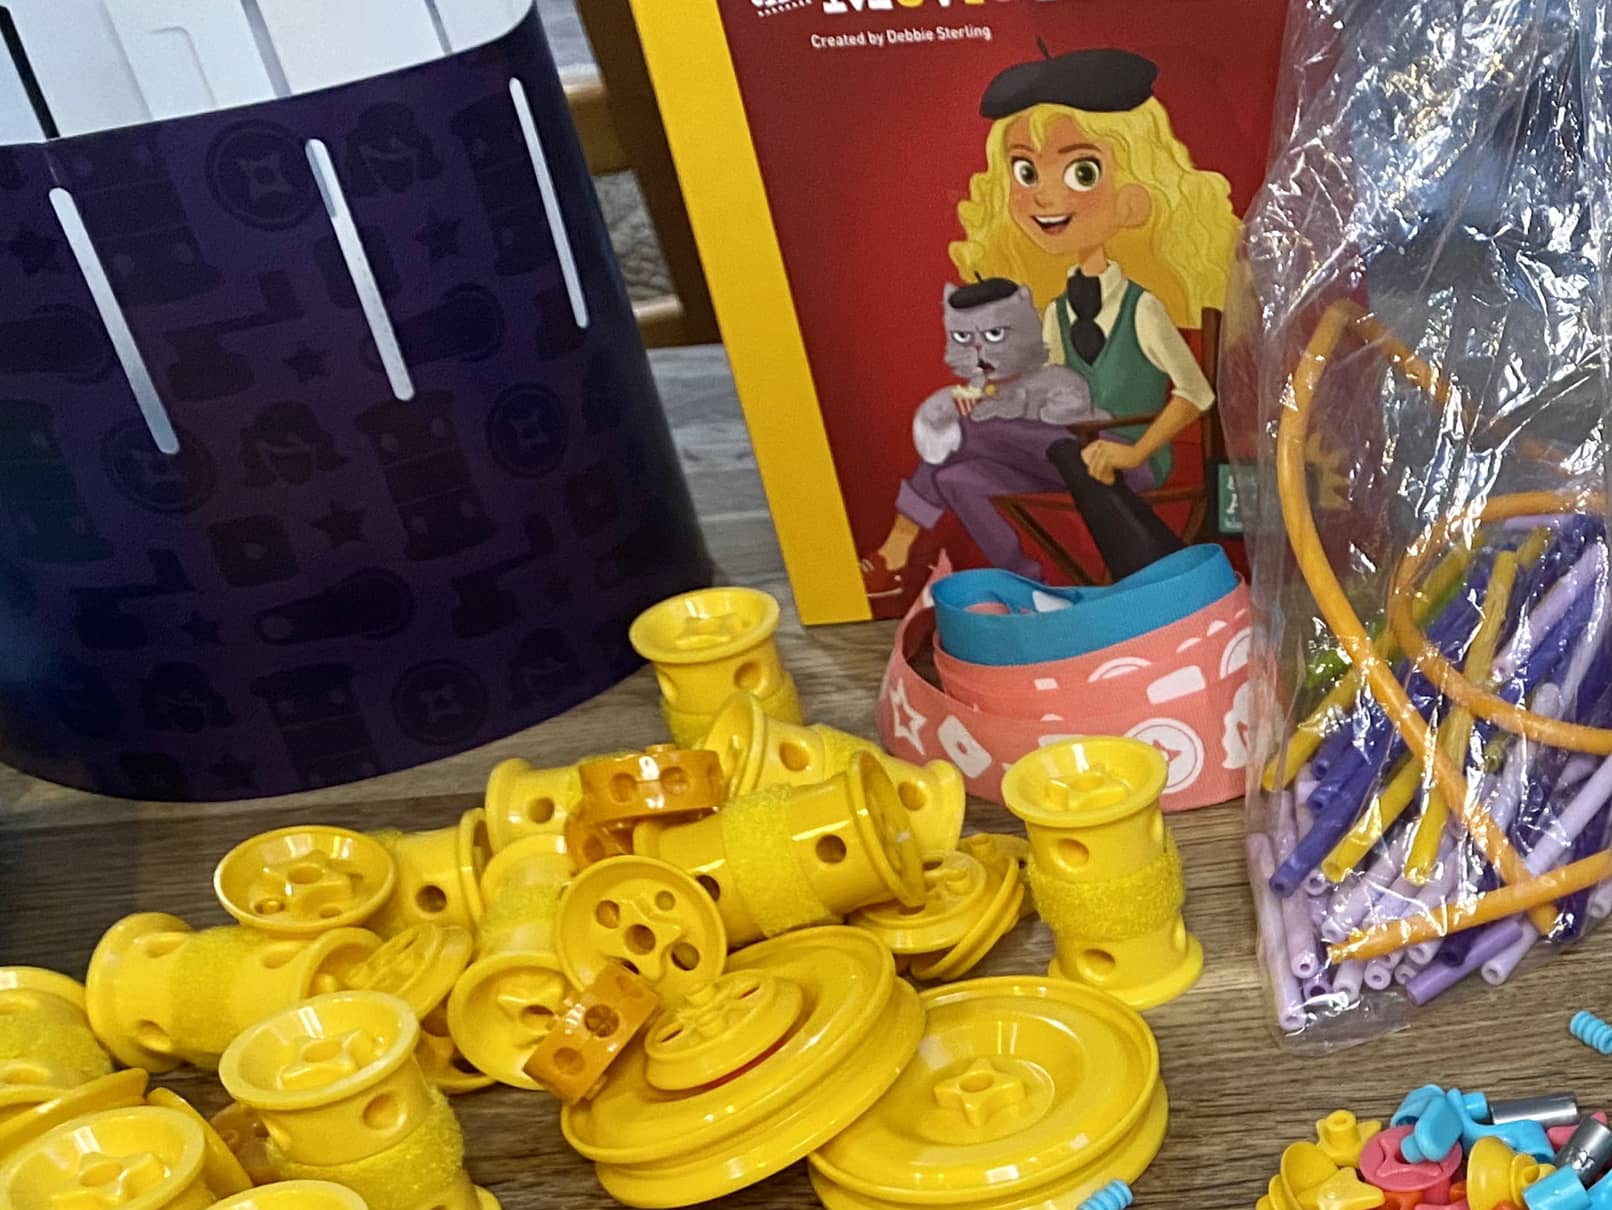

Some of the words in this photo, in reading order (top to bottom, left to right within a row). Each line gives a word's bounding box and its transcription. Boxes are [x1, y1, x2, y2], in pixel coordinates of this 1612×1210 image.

[810, 31, 865, 48] Created
[868, 30, 885, 46] by
[887, 28, 934, 43] Debbie
[936, 24, 992, 42] Sterling
